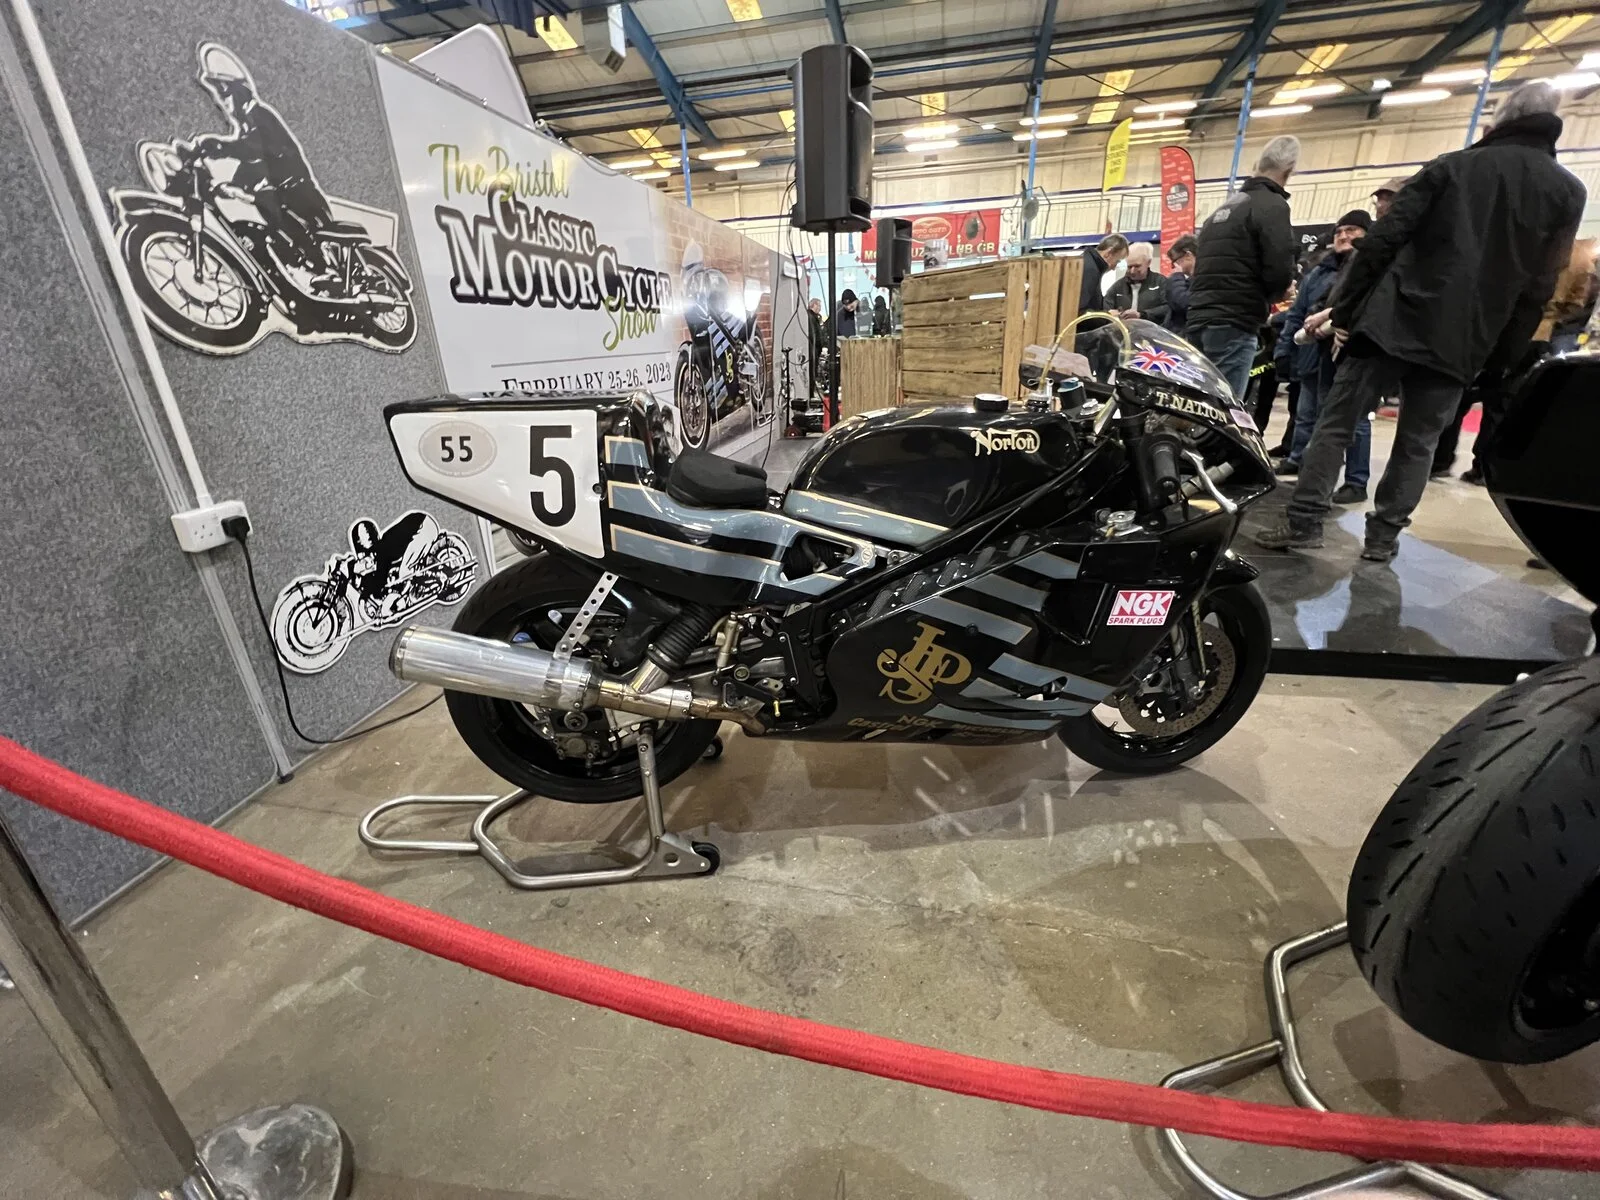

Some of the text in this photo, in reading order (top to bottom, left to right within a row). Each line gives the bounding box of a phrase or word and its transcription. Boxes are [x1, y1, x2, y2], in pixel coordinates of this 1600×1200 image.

[428, 143, 569, 203] The Bristol
[489, 186, 597, 258] CLASSIC
[602, 295, 657, 351] Show
[644, 361, 673, 385] 2023
[440, 435, 473, 463] 55
[970, 427, 1041, 457] Norton
[529, 424, 576, 528] 5
[1111, 592, 1172, 616] NGK
[1108, 617, 1164, 625] SPARK PLUGS
[896, 714, 944, 729] NGK
